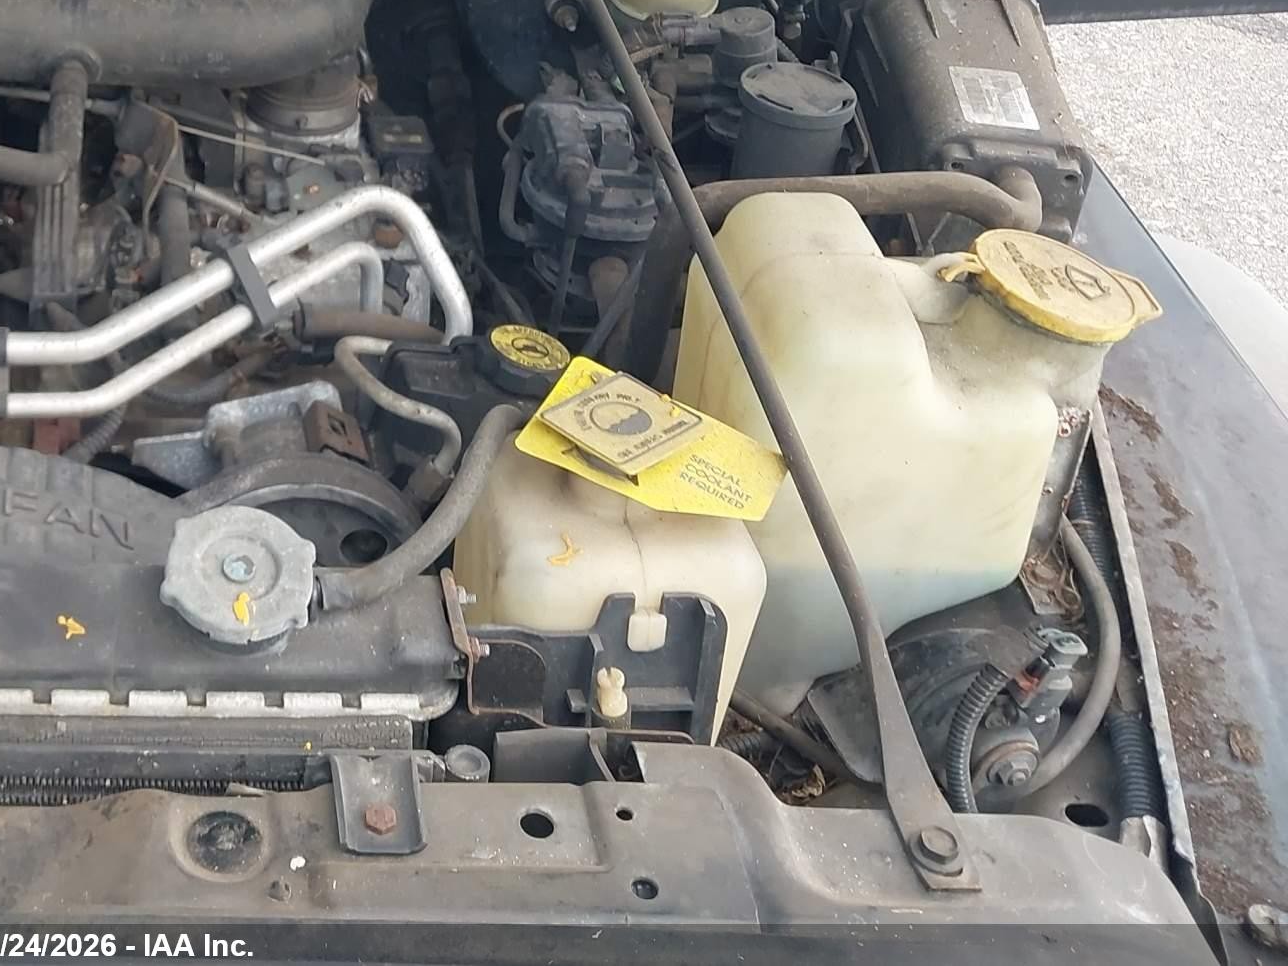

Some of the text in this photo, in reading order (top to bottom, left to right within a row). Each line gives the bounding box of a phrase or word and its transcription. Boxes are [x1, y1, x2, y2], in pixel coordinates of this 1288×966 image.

[684, 462, 753, 503] COOLANT
[689, 453, 741, 487] SPECIAL
[679, 471, 745, 510] REQUIRED
[2, 488, 135, 551] FAN
